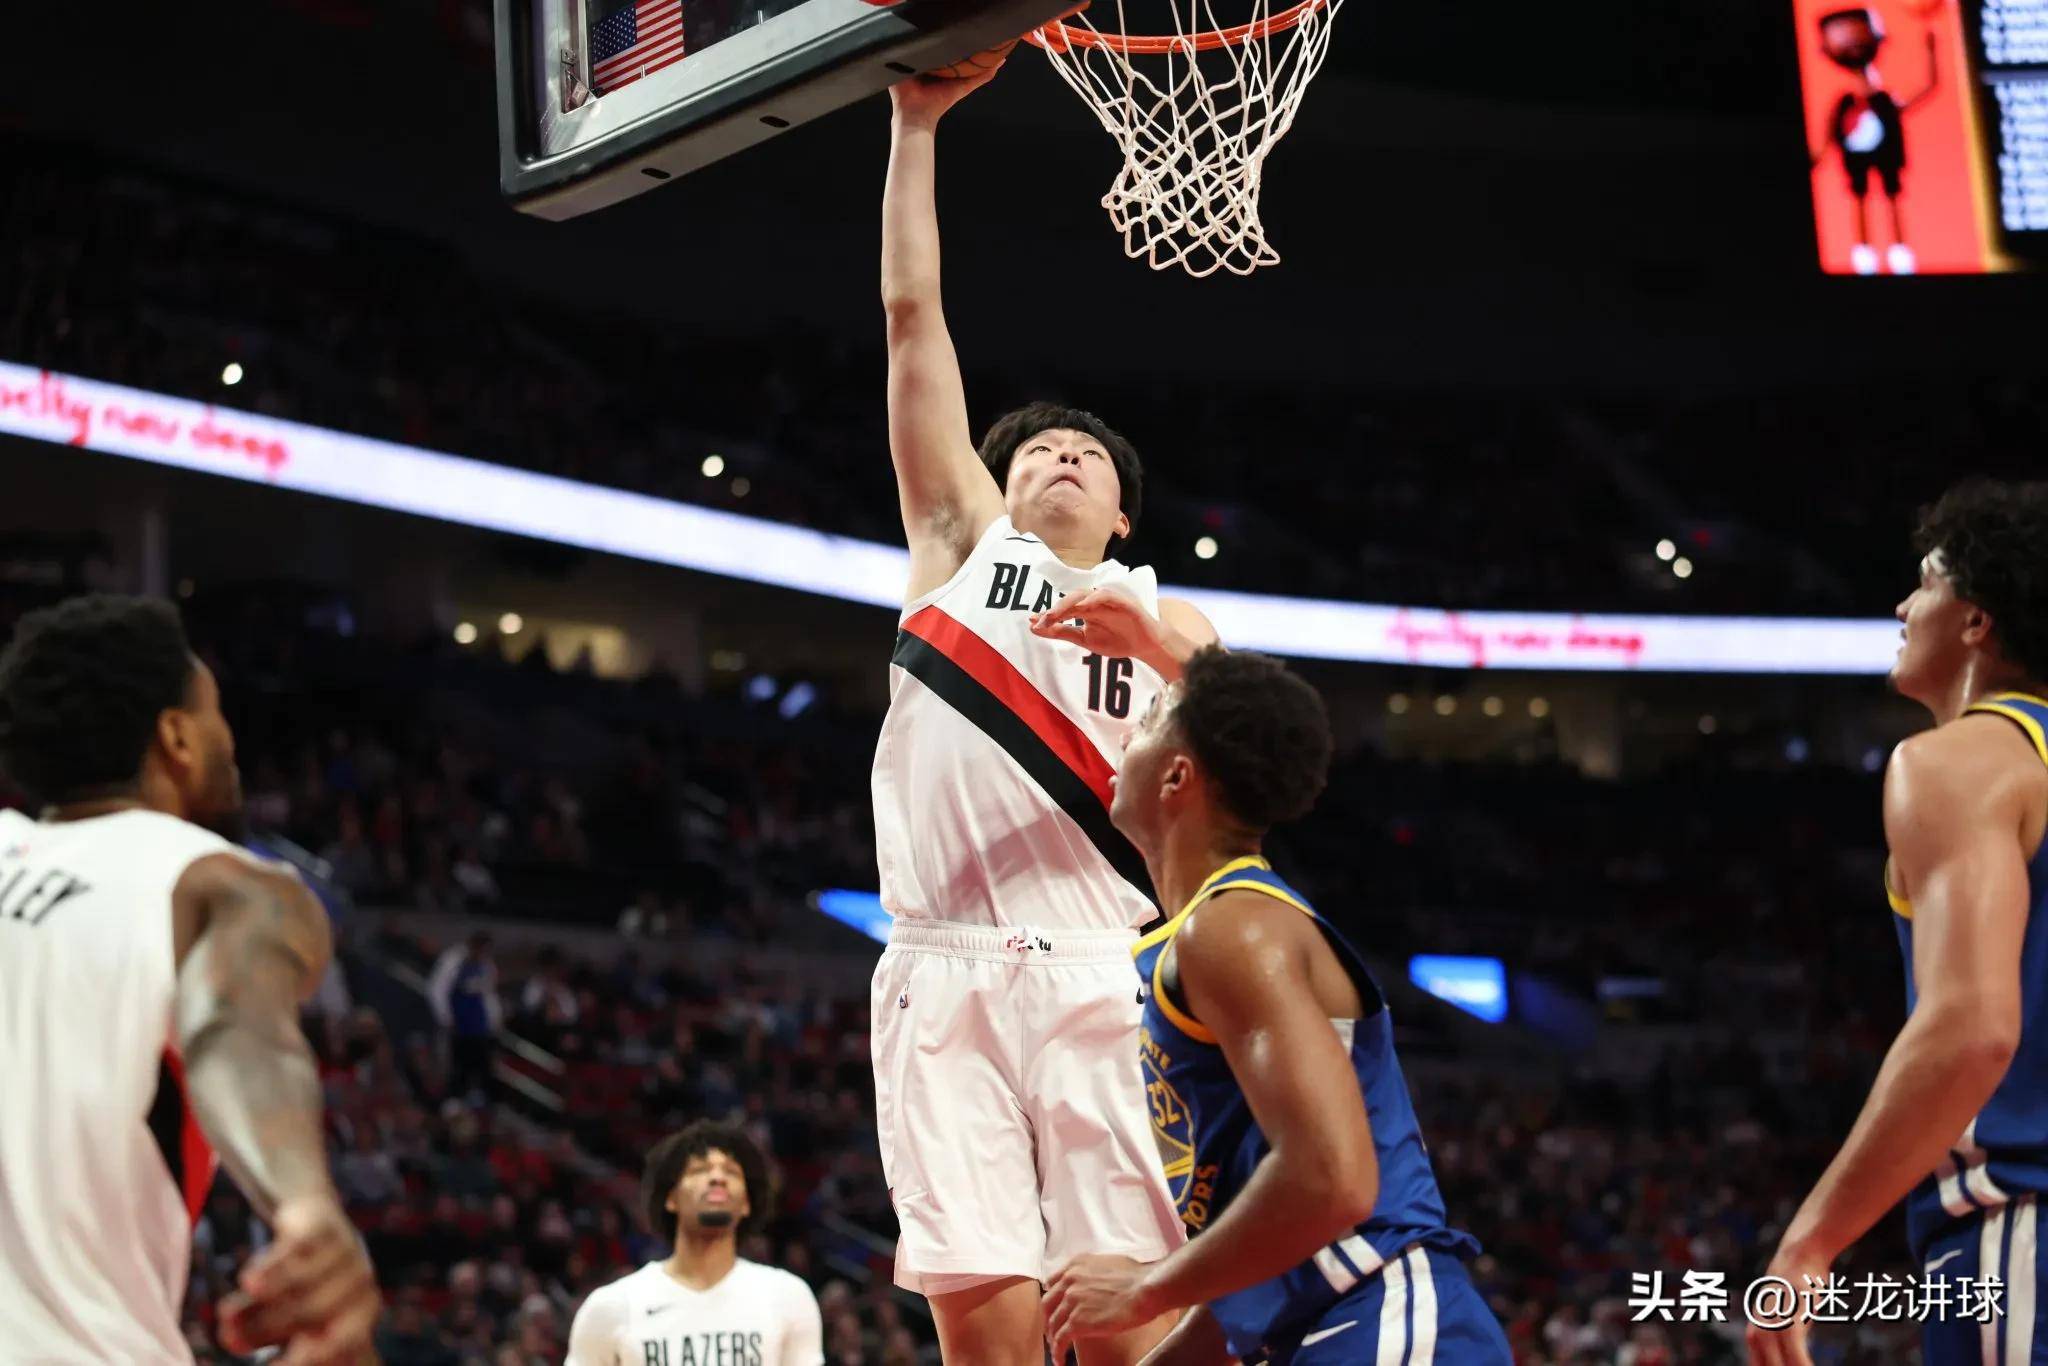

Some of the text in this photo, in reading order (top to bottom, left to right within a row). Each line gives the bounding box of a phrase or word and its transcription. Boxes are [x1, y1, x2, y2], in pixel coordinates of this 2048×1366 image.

[1082, 652, 1133, 719] 16
[0, 867, 91, 927] LEY
[643, 1332, 762, 1366] BLAZERS
